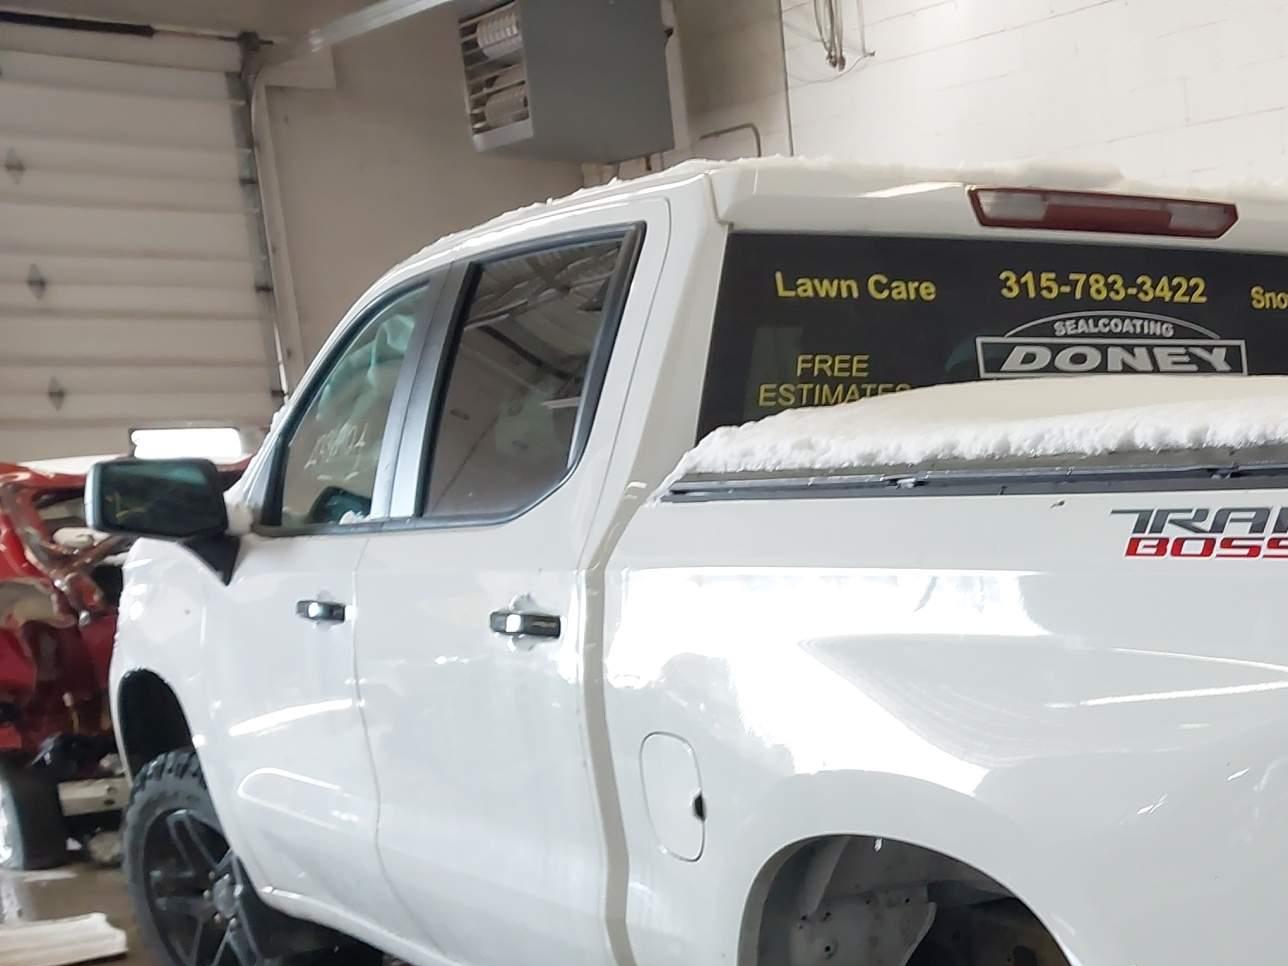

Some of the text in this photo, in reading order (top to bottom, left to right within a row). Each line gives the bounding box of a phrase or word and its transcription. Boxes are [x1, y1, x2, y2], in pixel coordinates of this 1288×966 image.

[775, 271, 937, 301] Lawn Care
[999, 270, 1208, 303] 315-783-3422
[1053, 317, 1175, 338] SEALCOATING
[796, 354, 870, 377] FREE
[1000, 344, 1232, 373] DONEY
